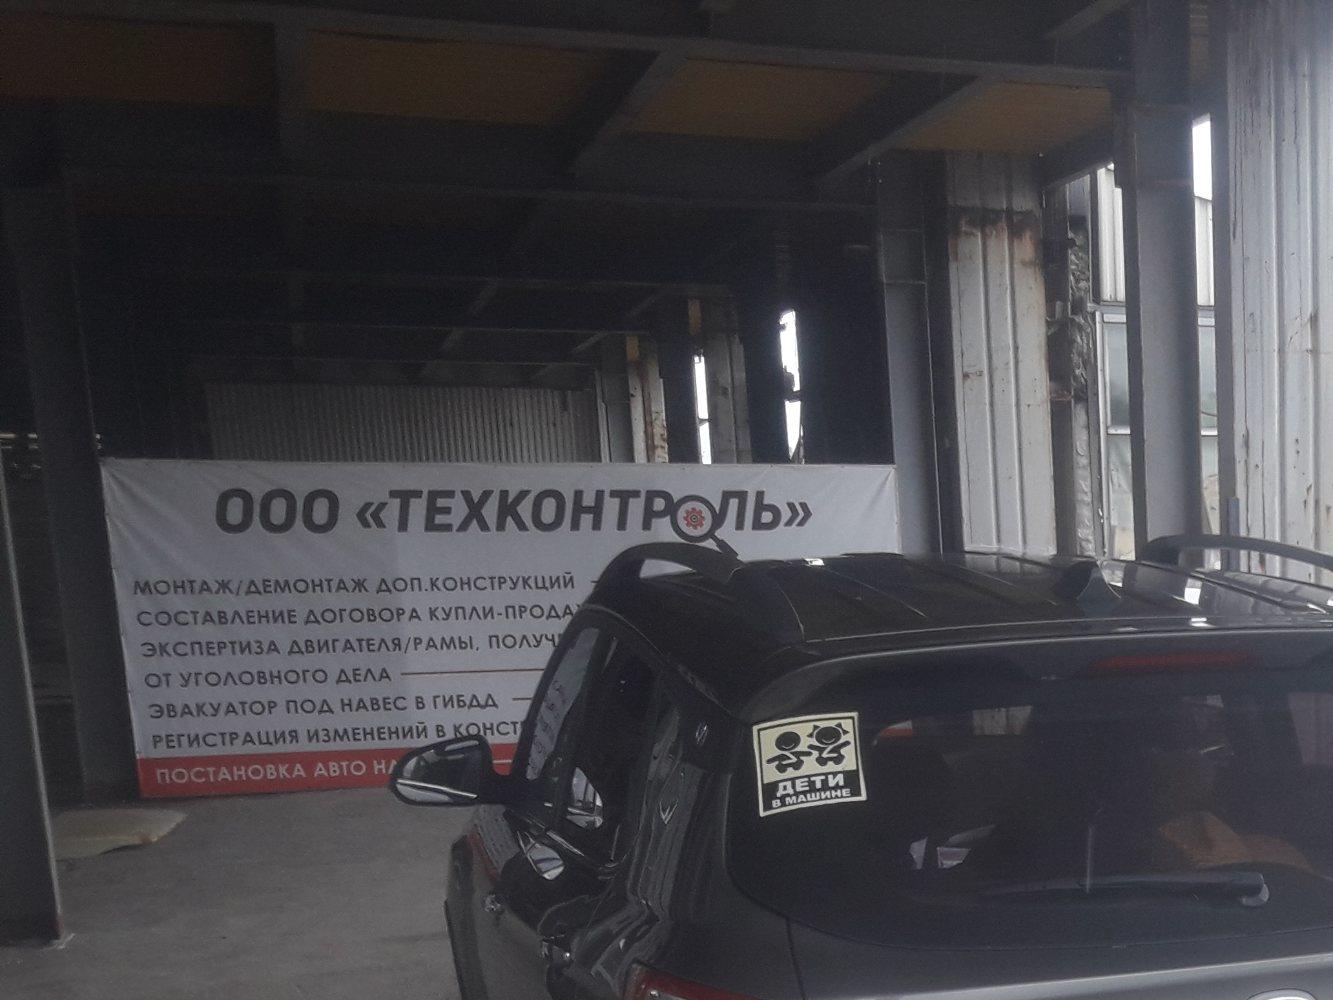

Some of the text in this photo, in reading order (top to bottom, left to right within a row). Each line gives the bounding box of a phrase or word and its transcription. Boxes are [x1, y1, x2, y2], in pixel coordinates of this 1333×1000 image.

[214, 487, 341, 535] ООО
[133, 577, 370, 597] МОНТАЖ/ДЕМОНТАЖ
[136, 603, 580, 627] СОСТАВЛЕНИЕ ДОГОВОРА КУПЛИ-ПРОДА
[140, 639, 281, 658] ЭКСПЕРТИЗА
[144, 667, 393, 689] ОТ УГОЛОВНОГО ДЕЛА
[149, 693, 499, 720] ЭВАКУАТОР ПОД НАВЕС В ГИБДД
[152, 721, 525, 750] РЕГИСТРАЦИЯ ИЗМЕНЕНИЙ В КОНСТ
[156, 762, 307, 785] ПОСТАНОВКА
[313, 759, 367, 779] АВТО
[776, 772, 846, 798] ДЕТИ
[771, 788, 853, 809] В МАШИНЕ
